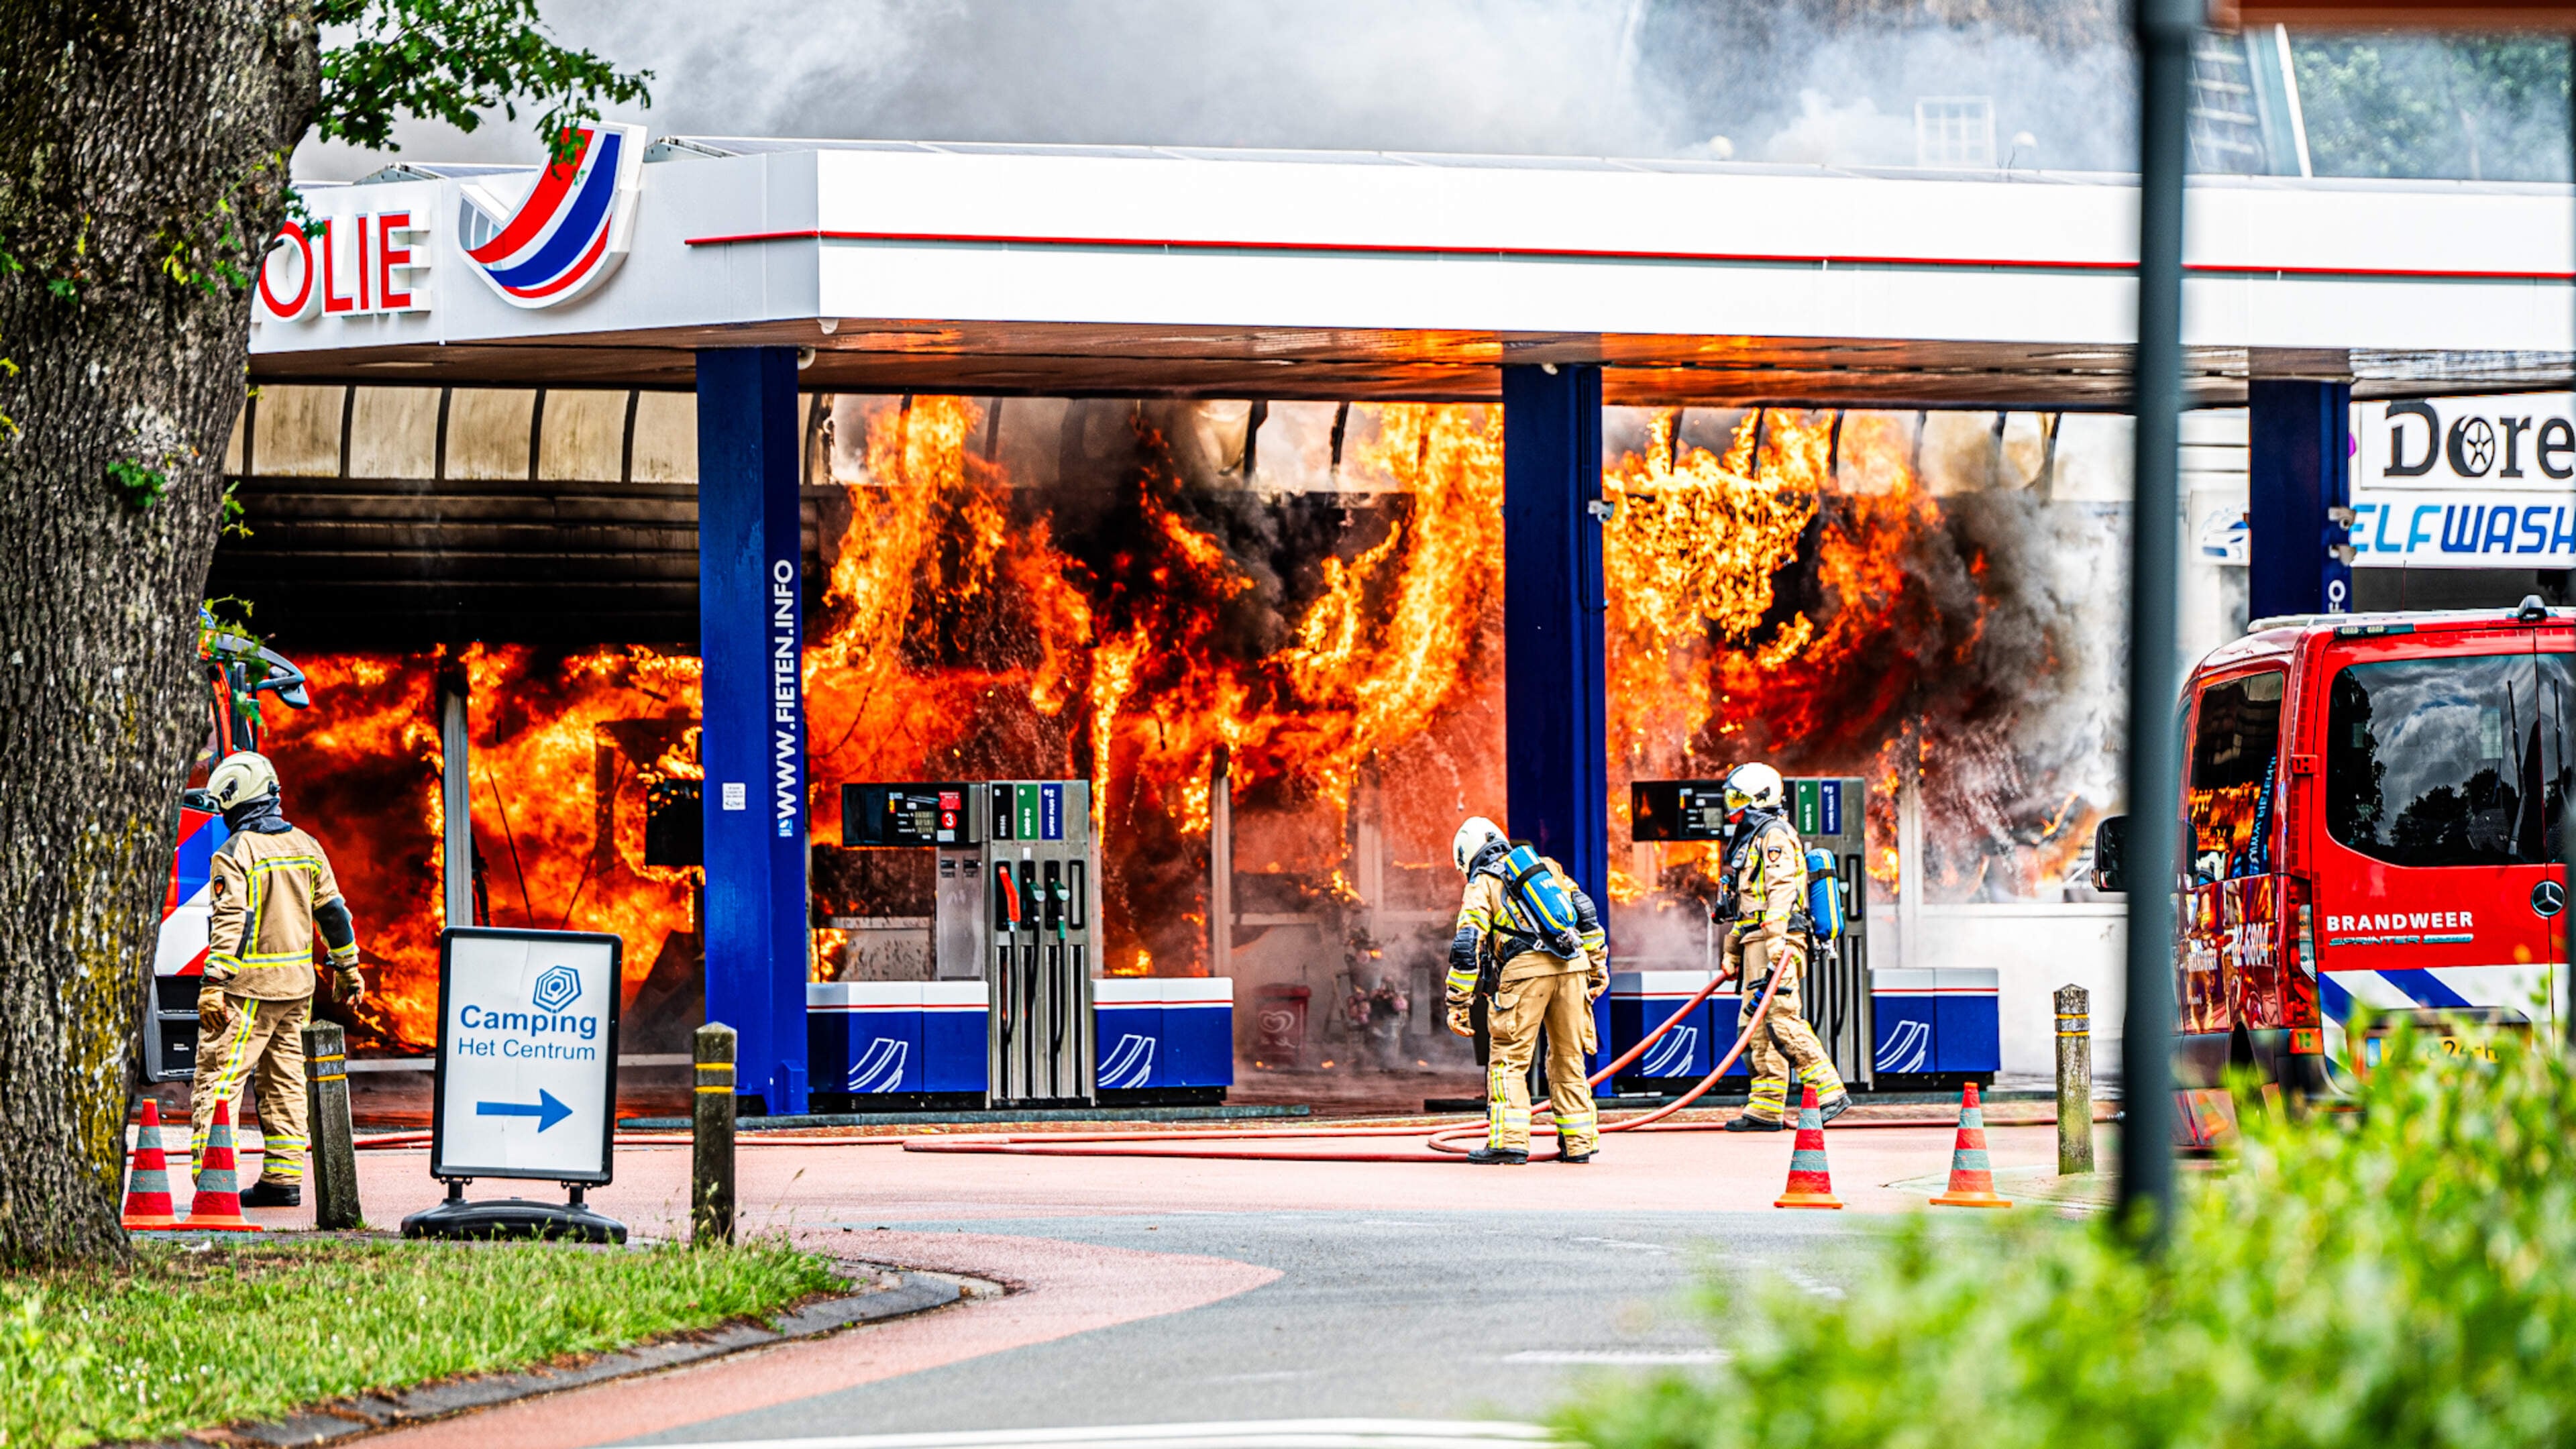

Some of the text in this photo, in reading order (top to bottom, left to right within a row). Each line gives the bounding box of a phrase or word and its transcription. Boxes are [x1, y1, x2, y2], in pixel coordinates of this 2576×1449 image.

[773, 559, 798, 820] WWW.FIETEN.INFO
[945, 812, 955, 827] 3
[2326, 911, 2474, 932] BRANDWEER
[2329, 934, 2420, 947] SPRINTER
[460, 1004, 597, 1040] Camping
[458, 1036, 596, 1061] Het Centrum
